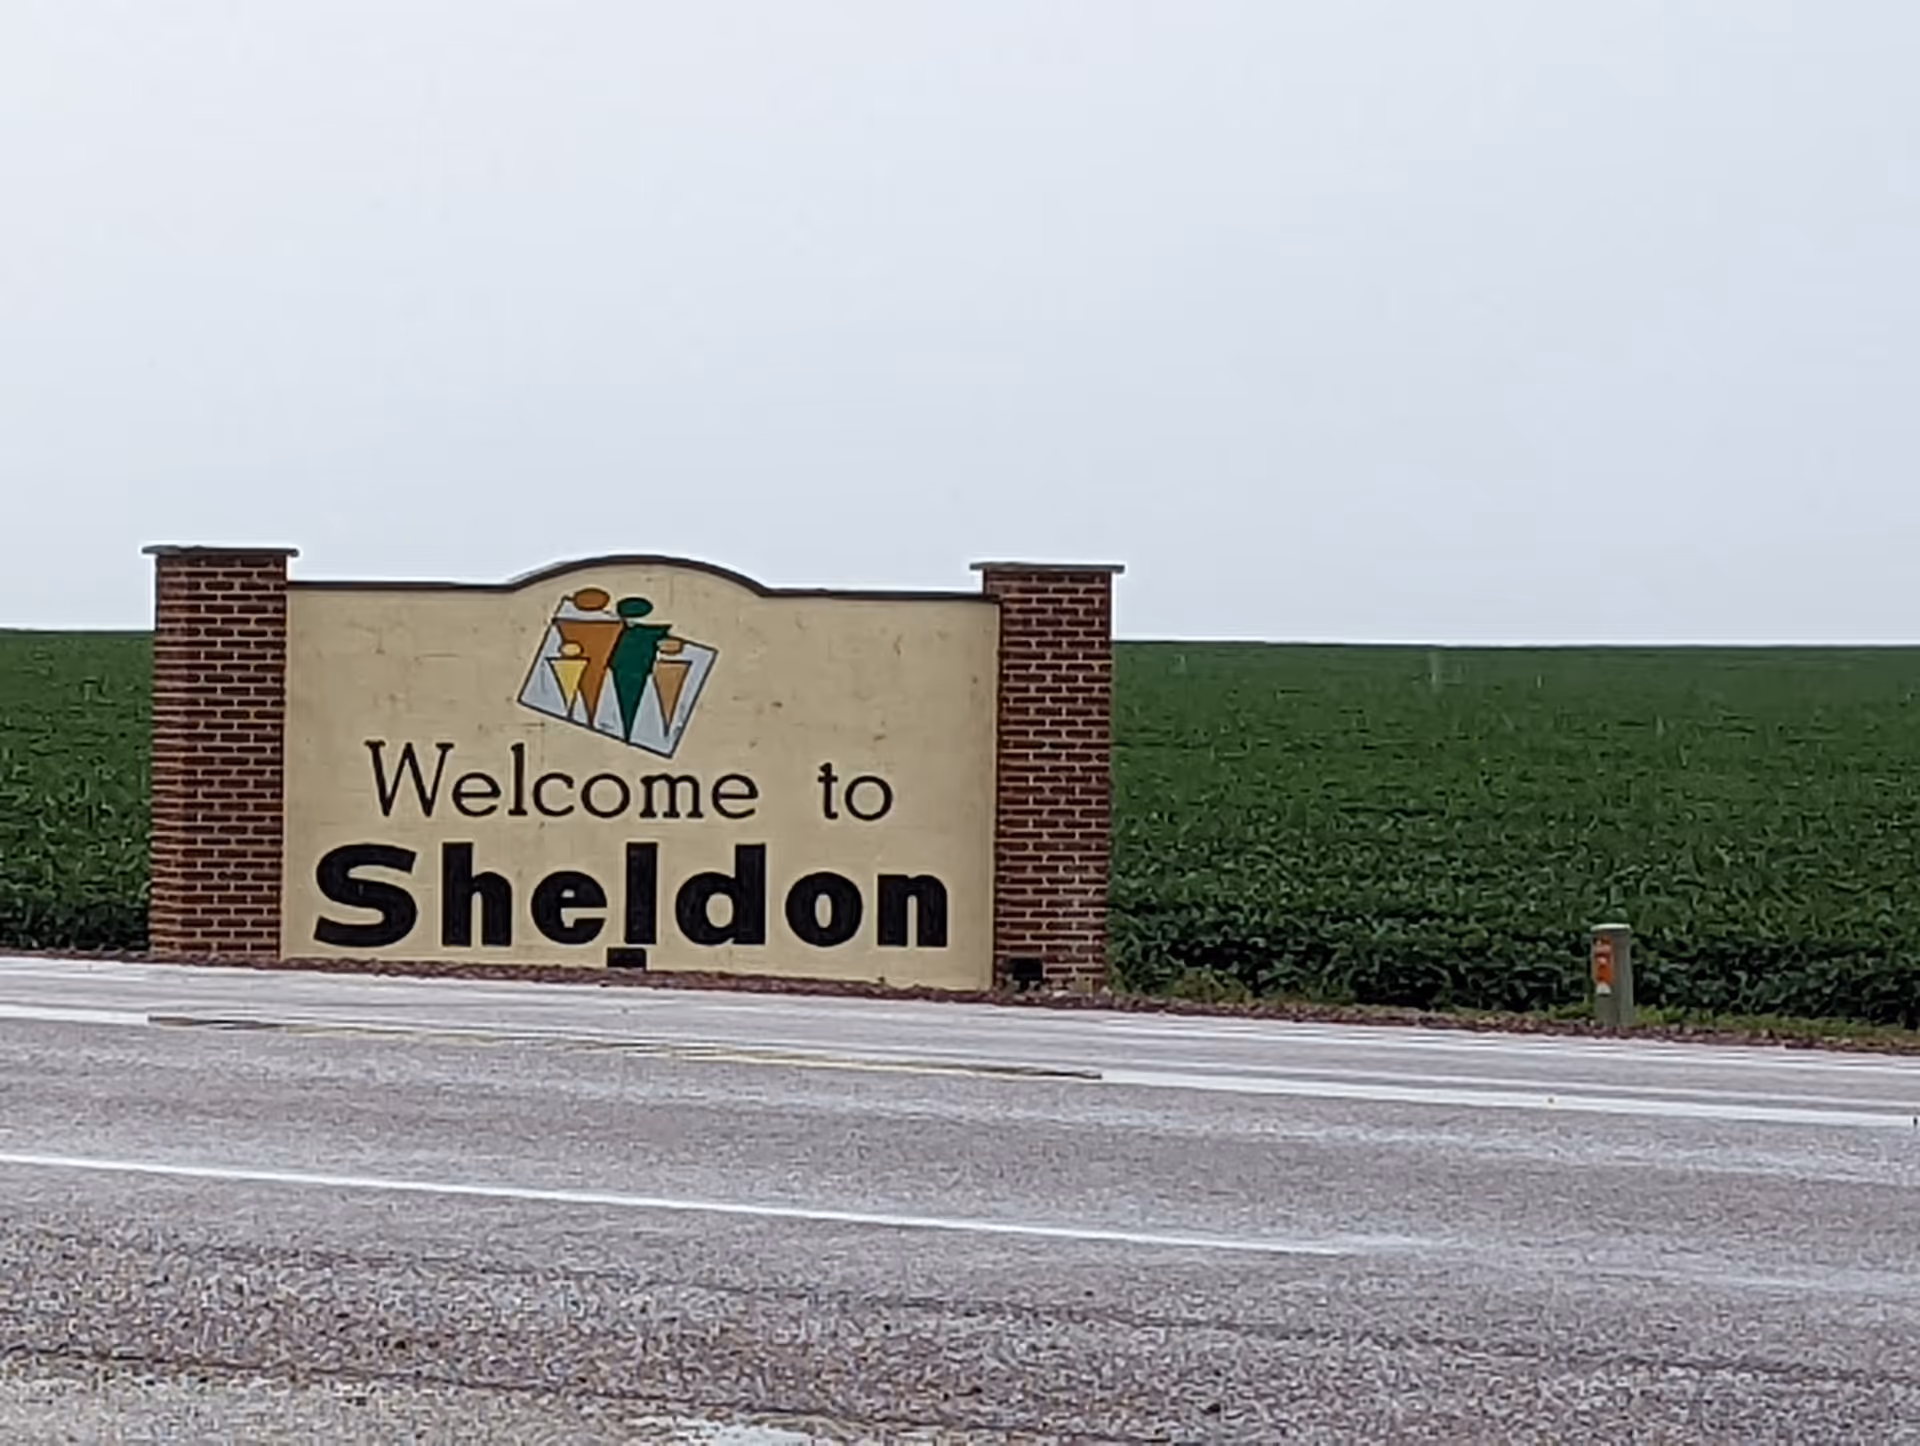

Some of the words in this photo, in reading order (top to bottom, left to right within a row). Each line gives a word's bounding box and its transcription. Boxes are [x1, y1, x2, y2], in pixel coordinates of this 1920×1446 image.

[364, 739, 759, 820] Welcome
[817, 762, 893, 822] to
[313, 842, 949, 948] Sheldon
